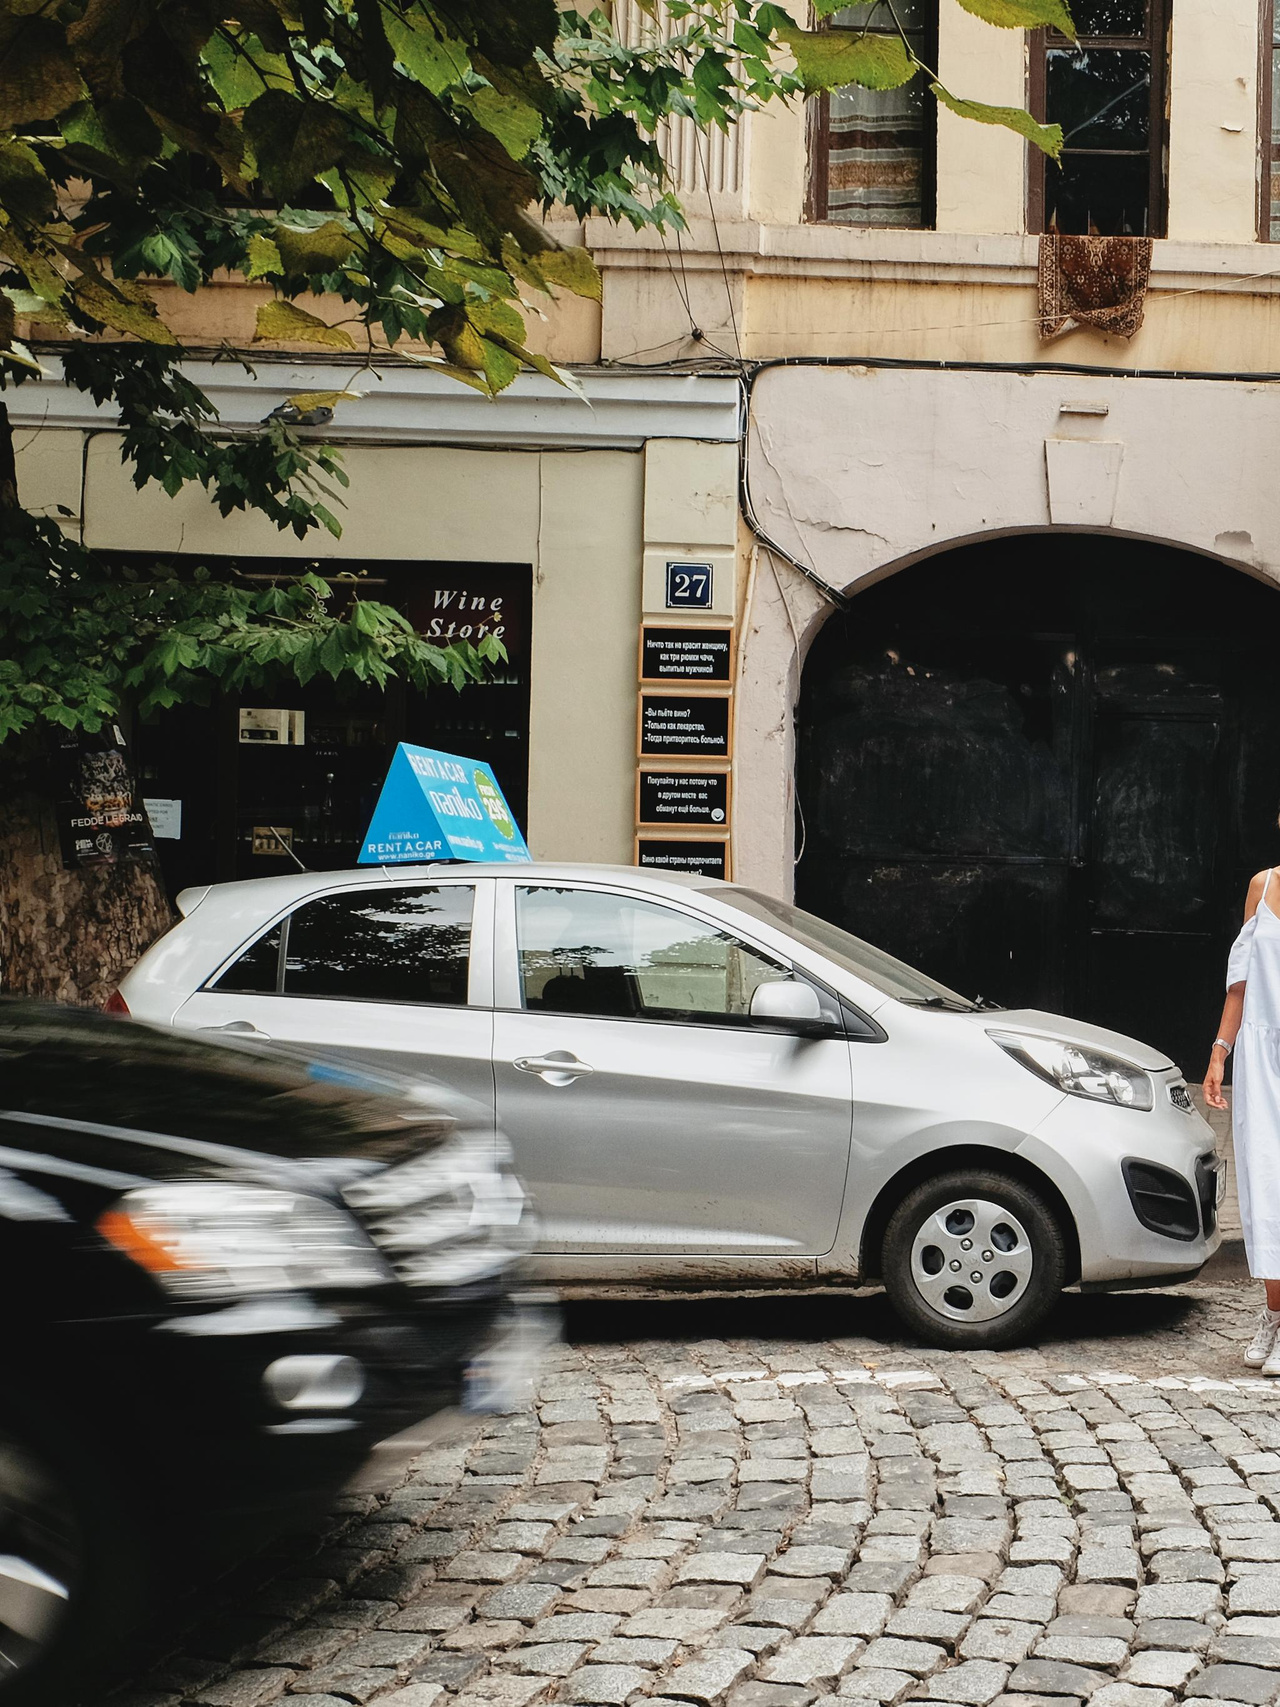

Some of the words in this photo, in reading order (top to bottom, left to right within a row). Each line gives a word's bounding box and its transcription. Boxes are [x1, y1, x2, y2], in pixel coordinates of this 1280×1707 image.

[674, 573, 707, 598] 27
[434, 590, 503, 611] Wine
[427, 618, 505, 639] Store
[646, 639, 665, 649] Ничто
[665, 641, 674, 649] так
[675, 641, 682, 649] не
[682, 642, 701, 651] красит
[660, 653, 669, 661] как
[670, 653, 680, 662] три
[680, 654, 700, 662] рюмки
[659, 665, 684, 673] выпитые
[685, 665, 713, 675] мужчиной
[657, 708, 673, 717] пьёте
[674, 708, 691, 718] вино?
[667, 722, 676, 730] как
[676, 723, 706, 732] лекарство.
[663, 735, 700, 745] притворитесь
[407, 753, 439, 779] RENT
[444, 761, 469, 784] CAR
[647, 775, 674, 786] Покупайте
[689, 778, 708, 787] потому
[662, 791, 681, 800] другом
[429, 786, 483, 821] naniko
[656, 804, 677, 814] обманут
[678, 804, 689, 813] ещё
[71, 815, 104, 828] FEDDE
[105, 814, 118, 824] LE
[388, 832, 419, 840] naniko
[368, 842, 402, 853] RENT
[405, 841, 413, 852] A
[415, 840, 442, 851] CAR
[378, 851, 436, 861] www.naniko.ge
[642, 854, 655, 863] Вино
[655, 854, 669, 864] какой
[669, 856, 687, 865] страны
[687, 857, 722, 866] предпочитаете
